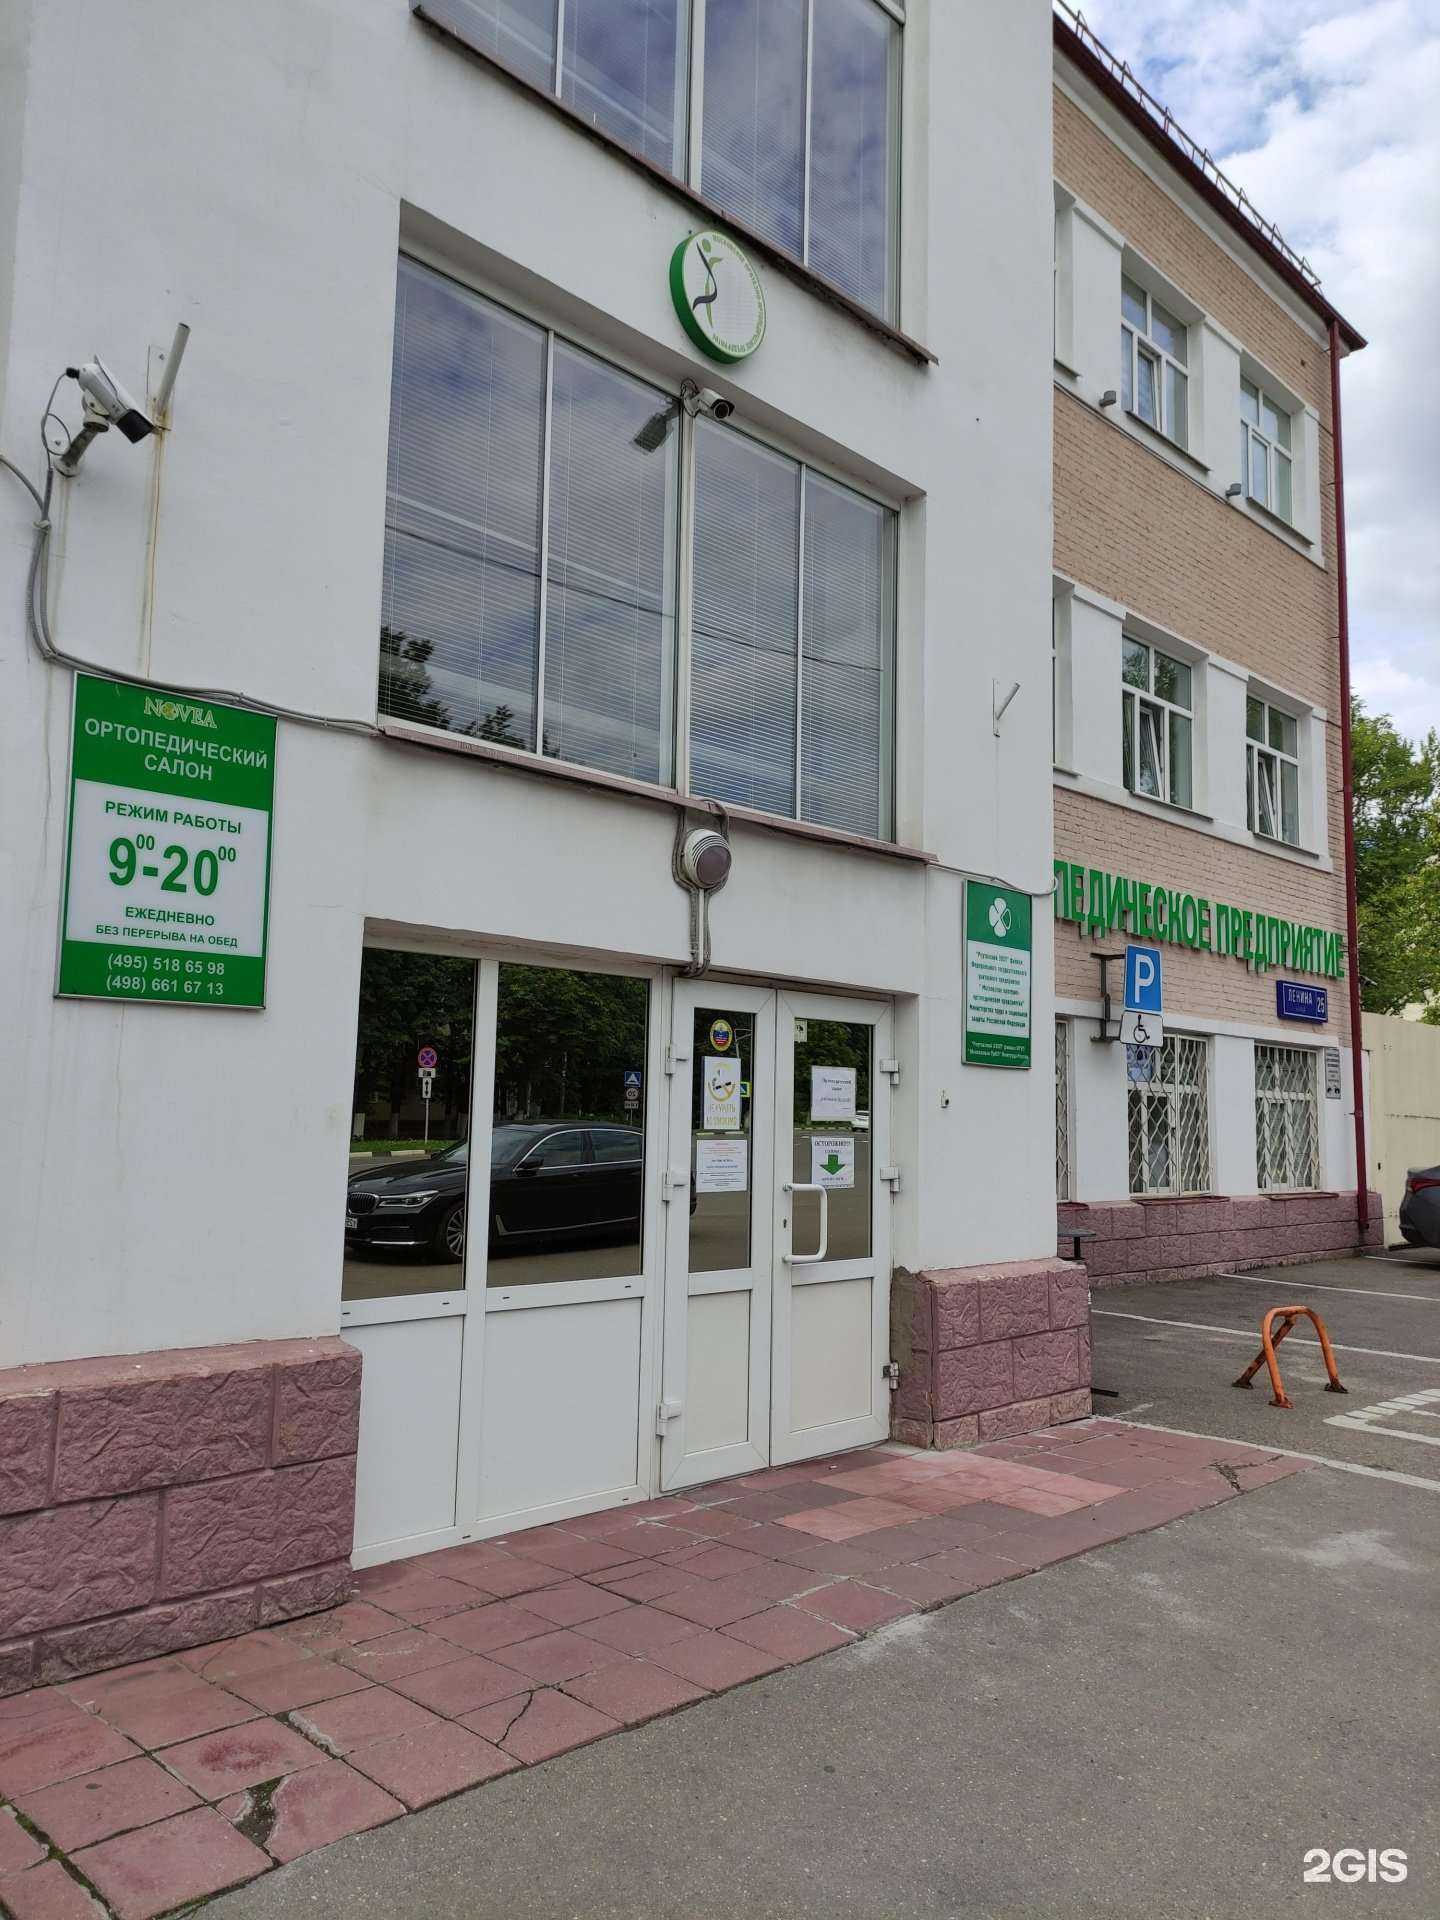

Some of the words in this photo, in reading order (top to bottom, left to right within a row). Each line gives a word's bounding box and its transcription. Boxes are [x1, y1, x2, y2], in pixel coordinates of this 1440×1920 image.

[84, 718, 268, 769] ОРТОПЕДИЧЕСКИЙ
[144, 754, 213, 781] САЛОН
[105, 800, 168, 823] РЕЖИМ
[173, 812, 242, 834] РАБОТЫ
[125, 906, 215, 926] ЕЖЕДНЕВНО
[96, 924, 119, 936] БЕЗ
[123, 927, 187, 942] ПЕРЕРЫВА
[190, 934, 205, 944] НА
[208, 935, 238, 948] ОБЕД
[1216, 903, 1345, 978] ПРЕДПРИЯТИЕ
[107, 953, 148, 972] (495)
[153, 958, 180, 972] 518
[185, 960, 203, 974] 65
[207, 962, 225, 976] 98
[106, 974, 147, 993] (498)
[151, 978, 178, 992] 661
[183, 981, 202, 994] 67
[207, 982, 224, 996] 13
[1134, 953, 1155, 1004] P
[1288, 988, 1313, 1005] ЛЕНИНА
[1317, 997, 1325, 1013] 25
